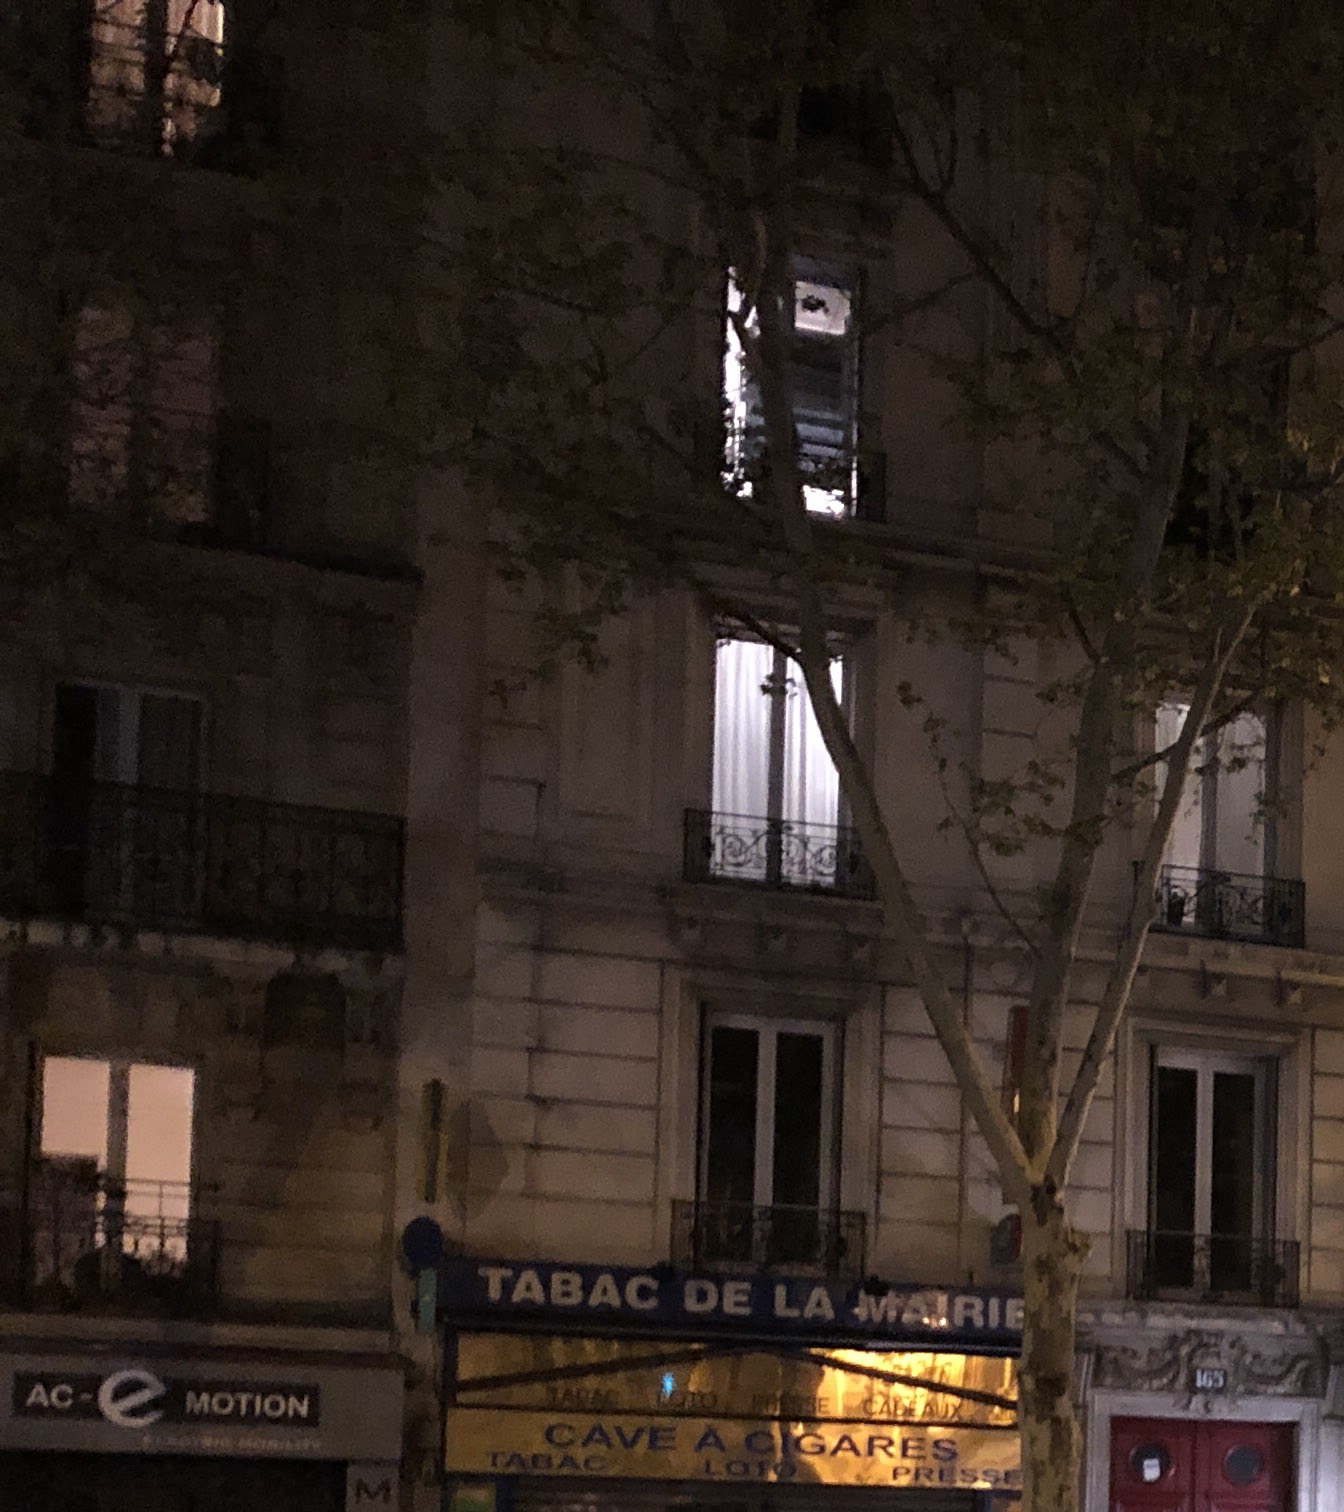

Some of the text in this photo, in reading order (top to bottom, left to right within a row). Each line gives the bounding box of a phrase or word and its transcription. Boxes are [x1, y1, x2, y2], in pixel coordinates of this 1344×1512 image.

[477, 1267, 660, 1310] TABAC
[683, 1279, 752, 1316] DE
[774, 1284, 836, 1321] LA
[185, 1390, 310, 1418] MOTION
[544, 1422, 676, 1451] CAVE
[744, 1431, 958, 1461] CIGARES
[488, 1451, 1023, 1485] TABAC LOTO PRESSE
